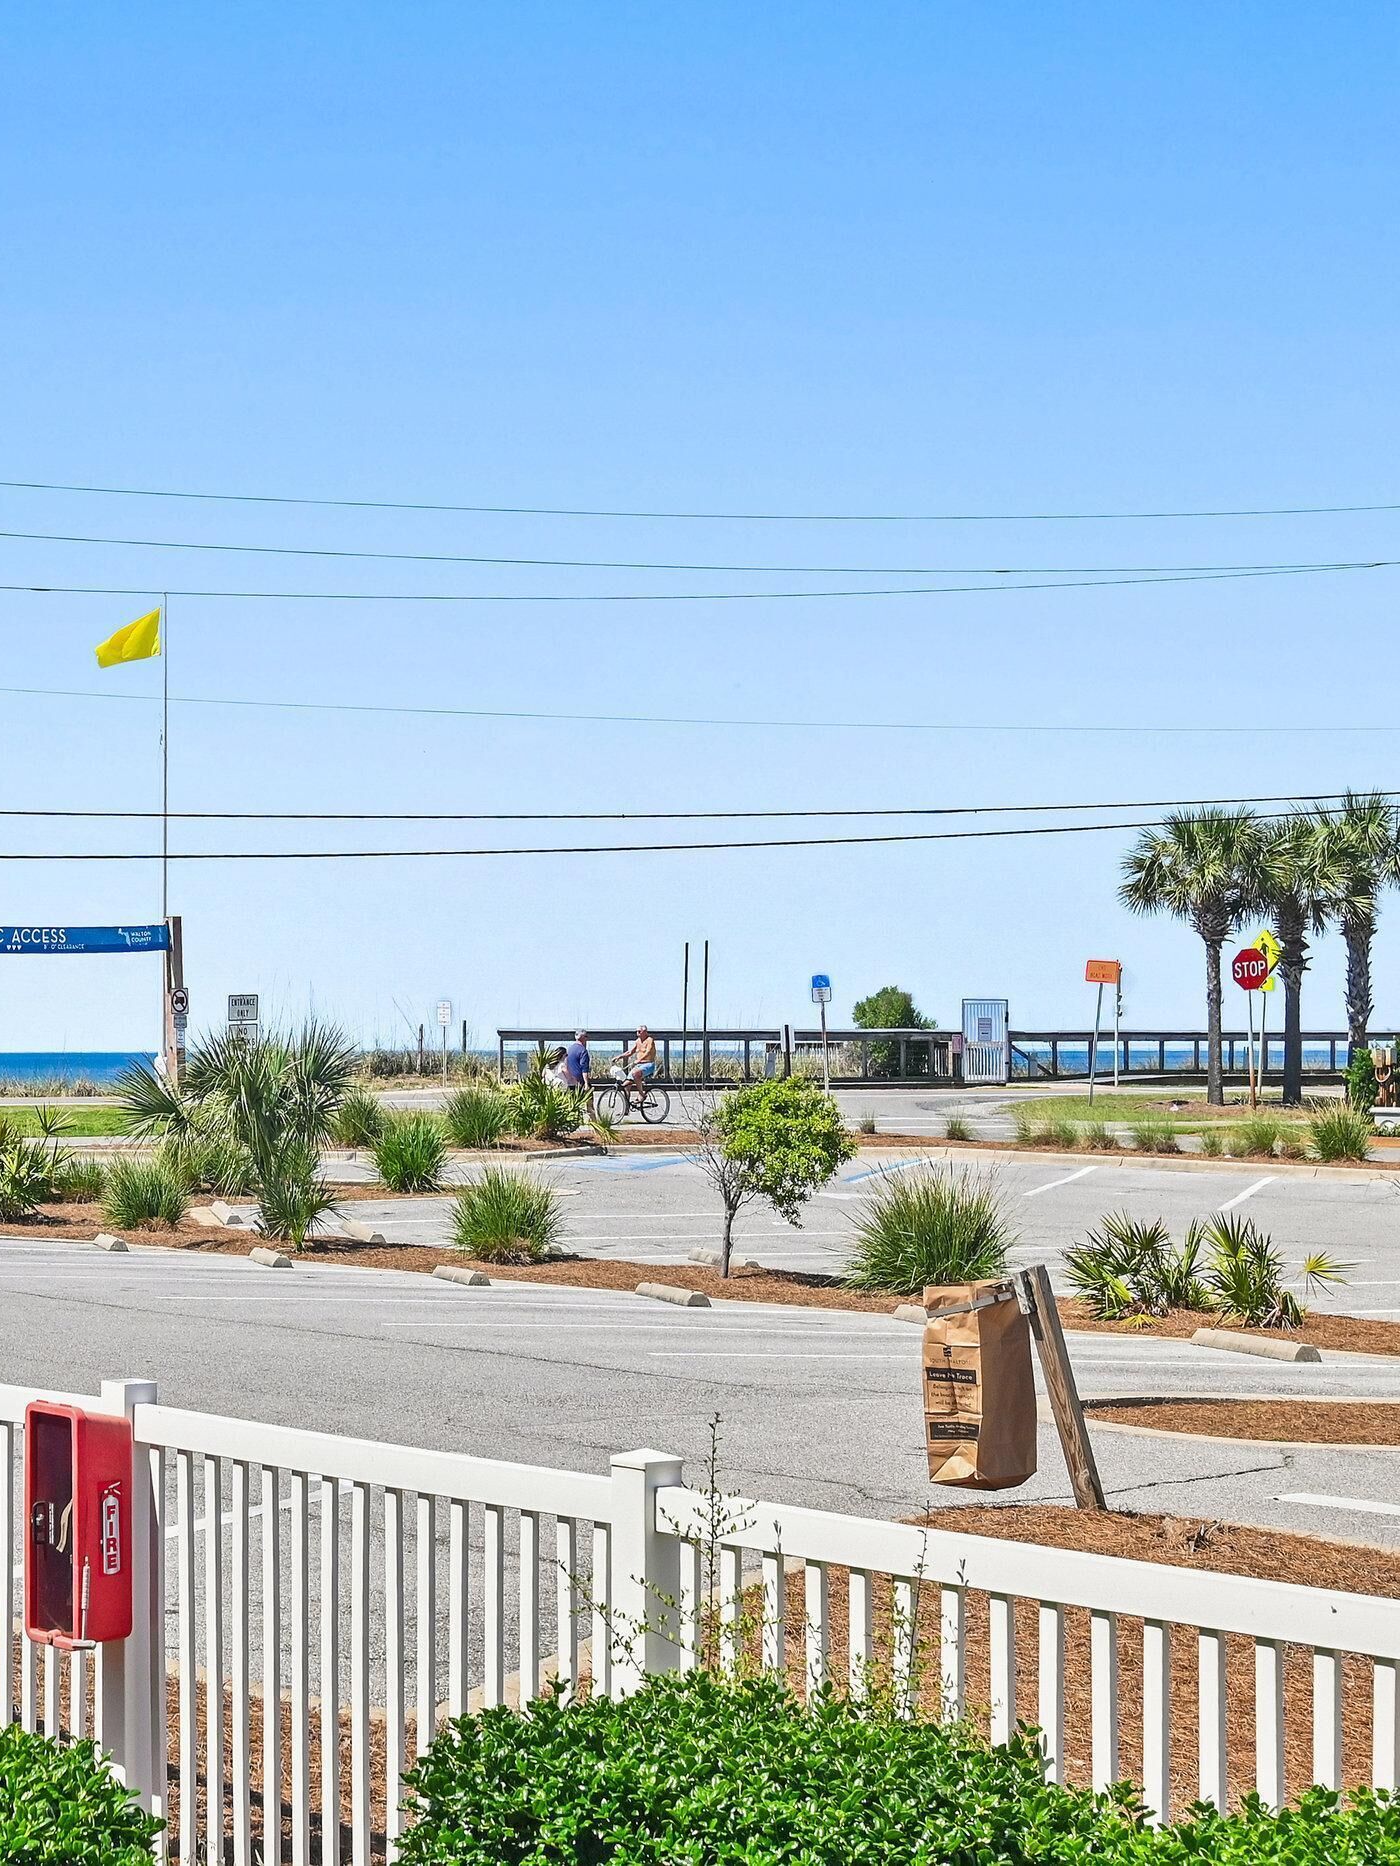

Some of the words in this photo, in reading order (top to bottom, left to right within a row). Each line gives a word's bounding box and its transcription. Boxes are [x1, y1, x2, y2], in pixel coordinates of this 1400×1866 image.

[11, 928, 67, 944] ACCESS
[1234, 960, 1266, 979] STOP
[231, 998, 255, 1007] ENTRANCE
[237, 1009, 249, 1018] ONLY
[238, 1027, 248, 1036] NO
[929, 1370, 946, 1379] Leave
[956, 1372, 973, 1381] Trace
[106, 1504, 118, 1570] FIRE
